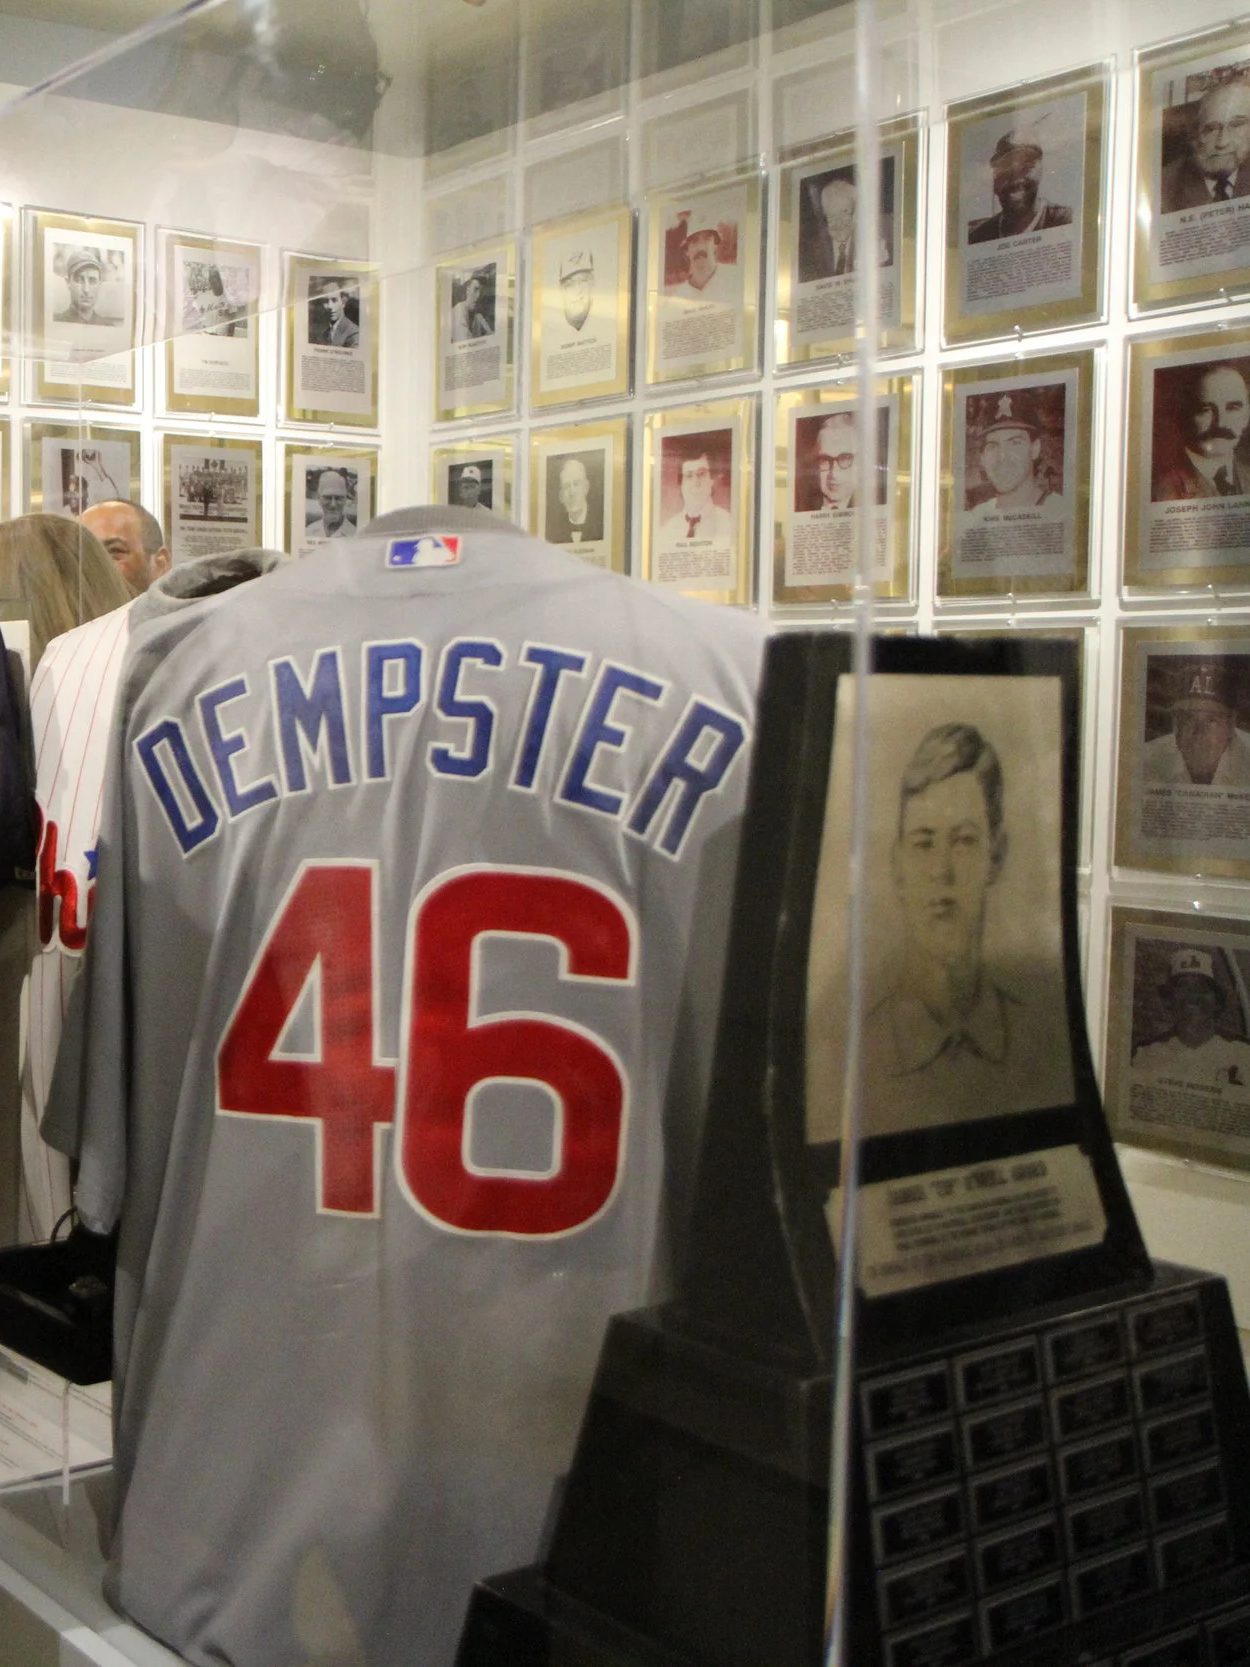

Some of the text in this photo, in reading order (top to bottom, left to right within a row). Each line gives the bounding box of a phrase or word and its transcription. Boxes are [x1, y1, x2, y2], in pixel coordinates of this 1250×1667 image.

[1165, 504, 1199, 514] JOSEPH
[1201, 502, 1225, 512] JOHN
[133, 636, 754, 861] DEMPSTER
[216, 857, 638, 1240] 46
